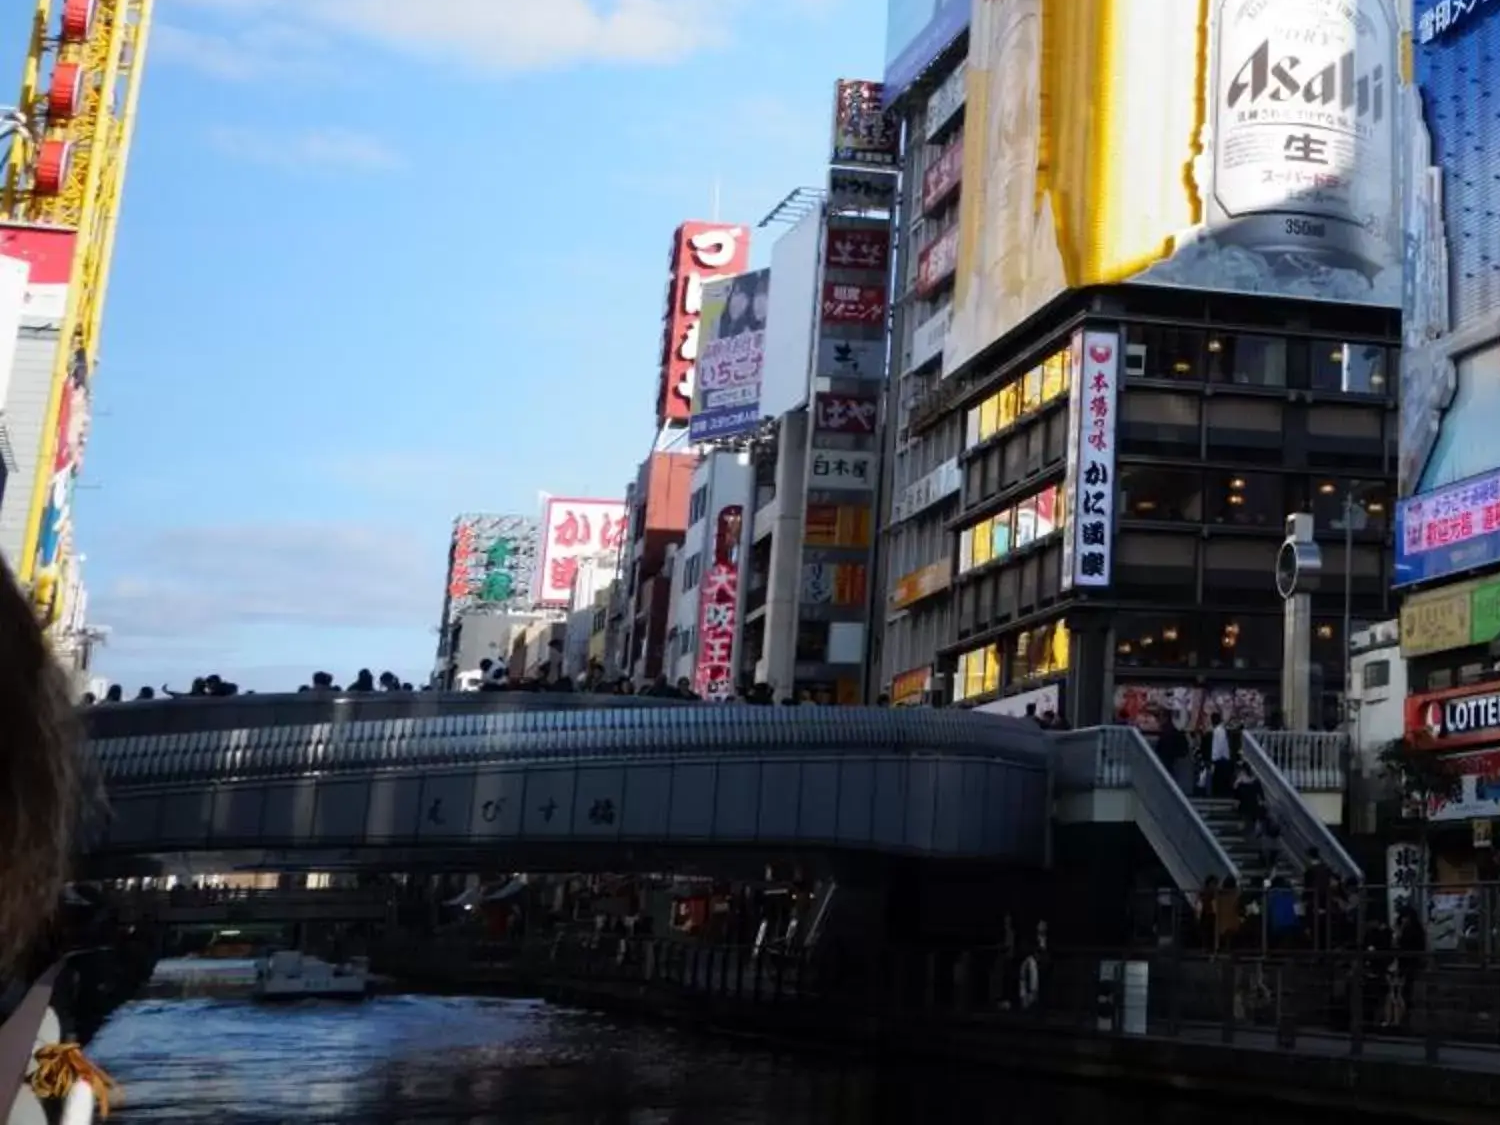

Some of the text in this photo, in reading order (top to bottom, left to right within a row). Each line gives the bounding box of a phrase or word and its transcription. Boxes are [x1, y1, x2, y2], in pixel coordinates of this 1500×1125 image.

[1226, 38, 1384, 124] Asahi
[1283, 133, 1330, 165] 生
[812, 454, 870, 478] 白木屋
